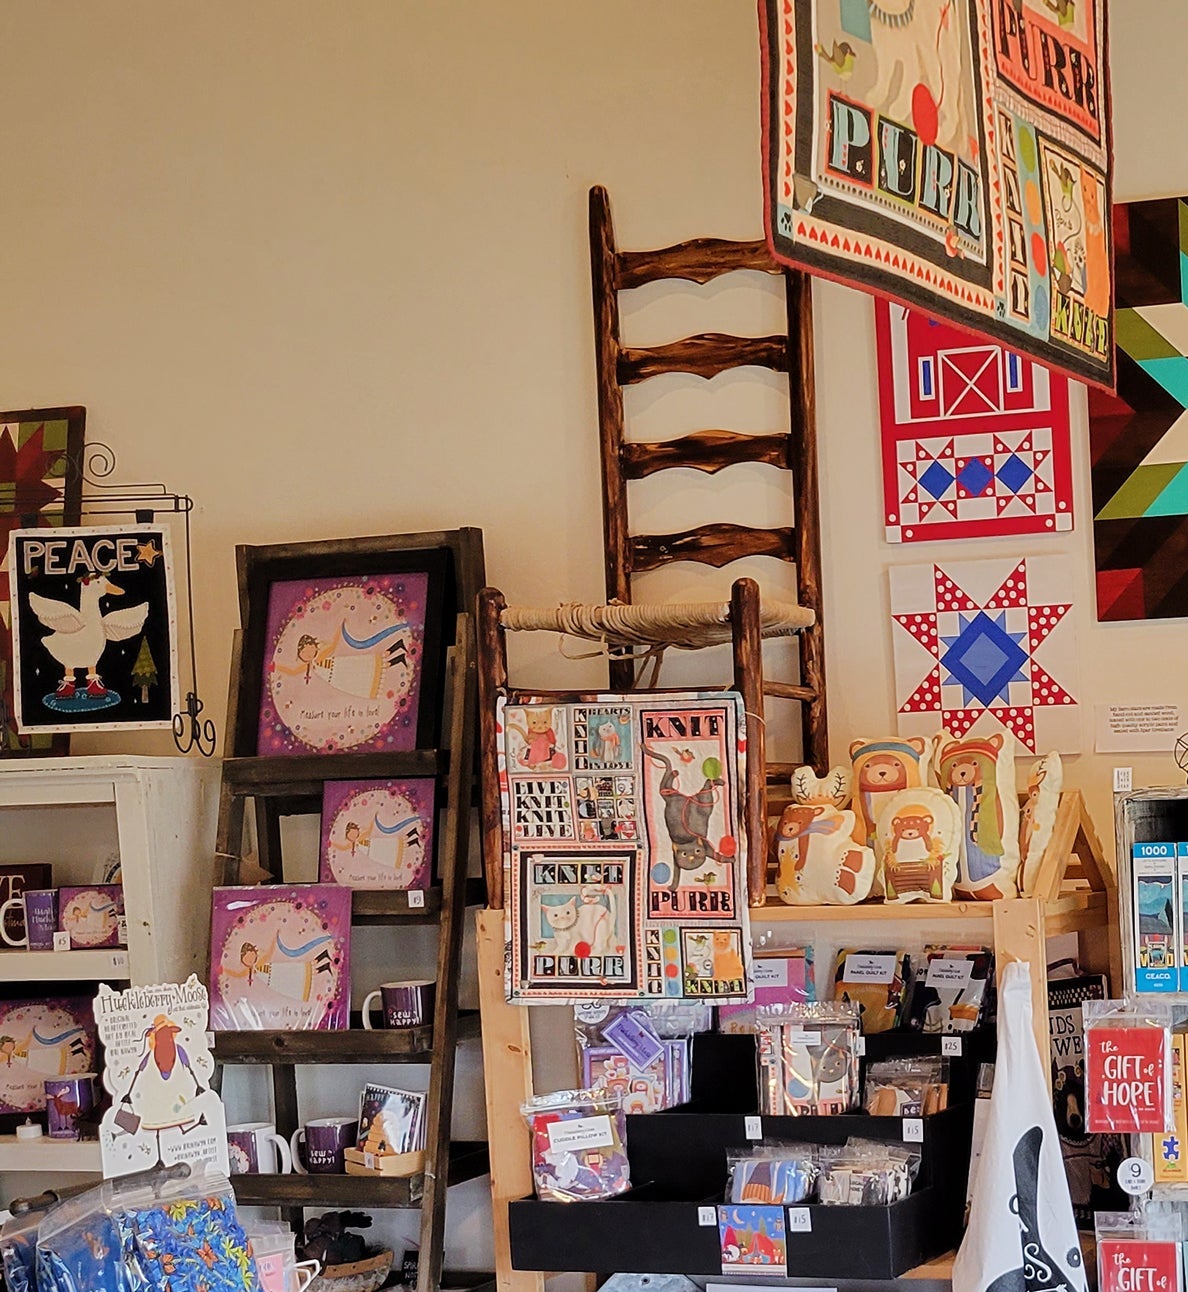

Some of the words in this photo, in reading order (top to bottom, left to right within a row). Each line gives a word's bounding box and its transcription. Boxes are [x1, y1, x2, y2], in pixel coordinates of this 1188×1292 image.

[1000, 4, 1096, 118] PURR
[830, 99, 982, 240] PURR
[24, 539, 139, 575] PEACE
[589, 707, 631, 715] HEARTS
[646, 716, 724, 738] KNIT
[515, 782, 567, 795] LIVE
[517, 796, 567, 809] KNIT
[517, 811, 571, 823] KNIT
[523, 825, 573, 837] LIVE
[1141, 846, 1167, 855] 1000
[652, 891, 732, 912] PURR
[534, 956, 624, 976] PURR
[101, 992, 173, 1015] Huckleberry
[175, 985, 207, 1006] Moose
[1100, 1041, 1119, 1053] the
[1104, 1055, 1145, 1079] GIFT
[1144, 1063, 1154, 1077] of
[1103, 1081, 1155, 1106] HOPE
[1112, 1252, 1131, 1265] the
[1118, 1267, 1157, 1291] GIFT
[1157, 1275, 1167, 1289] of
